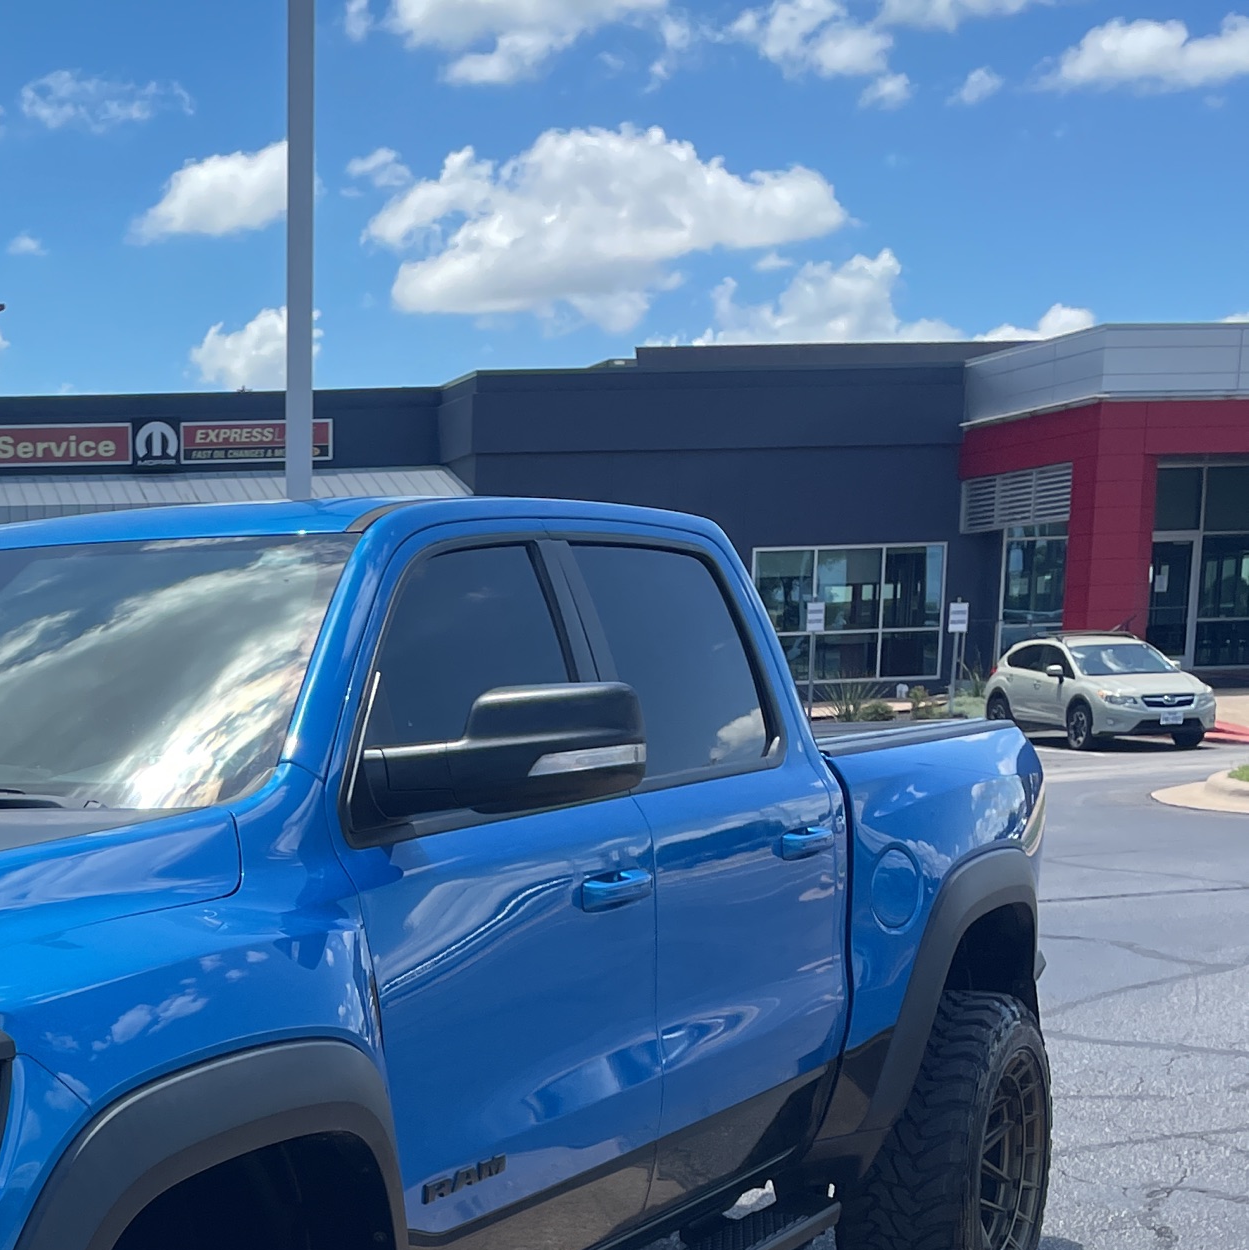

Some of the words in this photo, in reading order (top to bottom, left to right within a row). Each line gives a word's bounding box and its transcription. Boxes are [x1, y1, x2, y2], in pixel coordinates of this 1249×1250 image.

[195, 427, 286, 443] EXPRESSL
[191, 450, 212, 459] FAST
[213, 450, 226, 459] OIL
[227, 449, 265, 458] CHANGES
[421, 1152, 507, 1205] RAM
